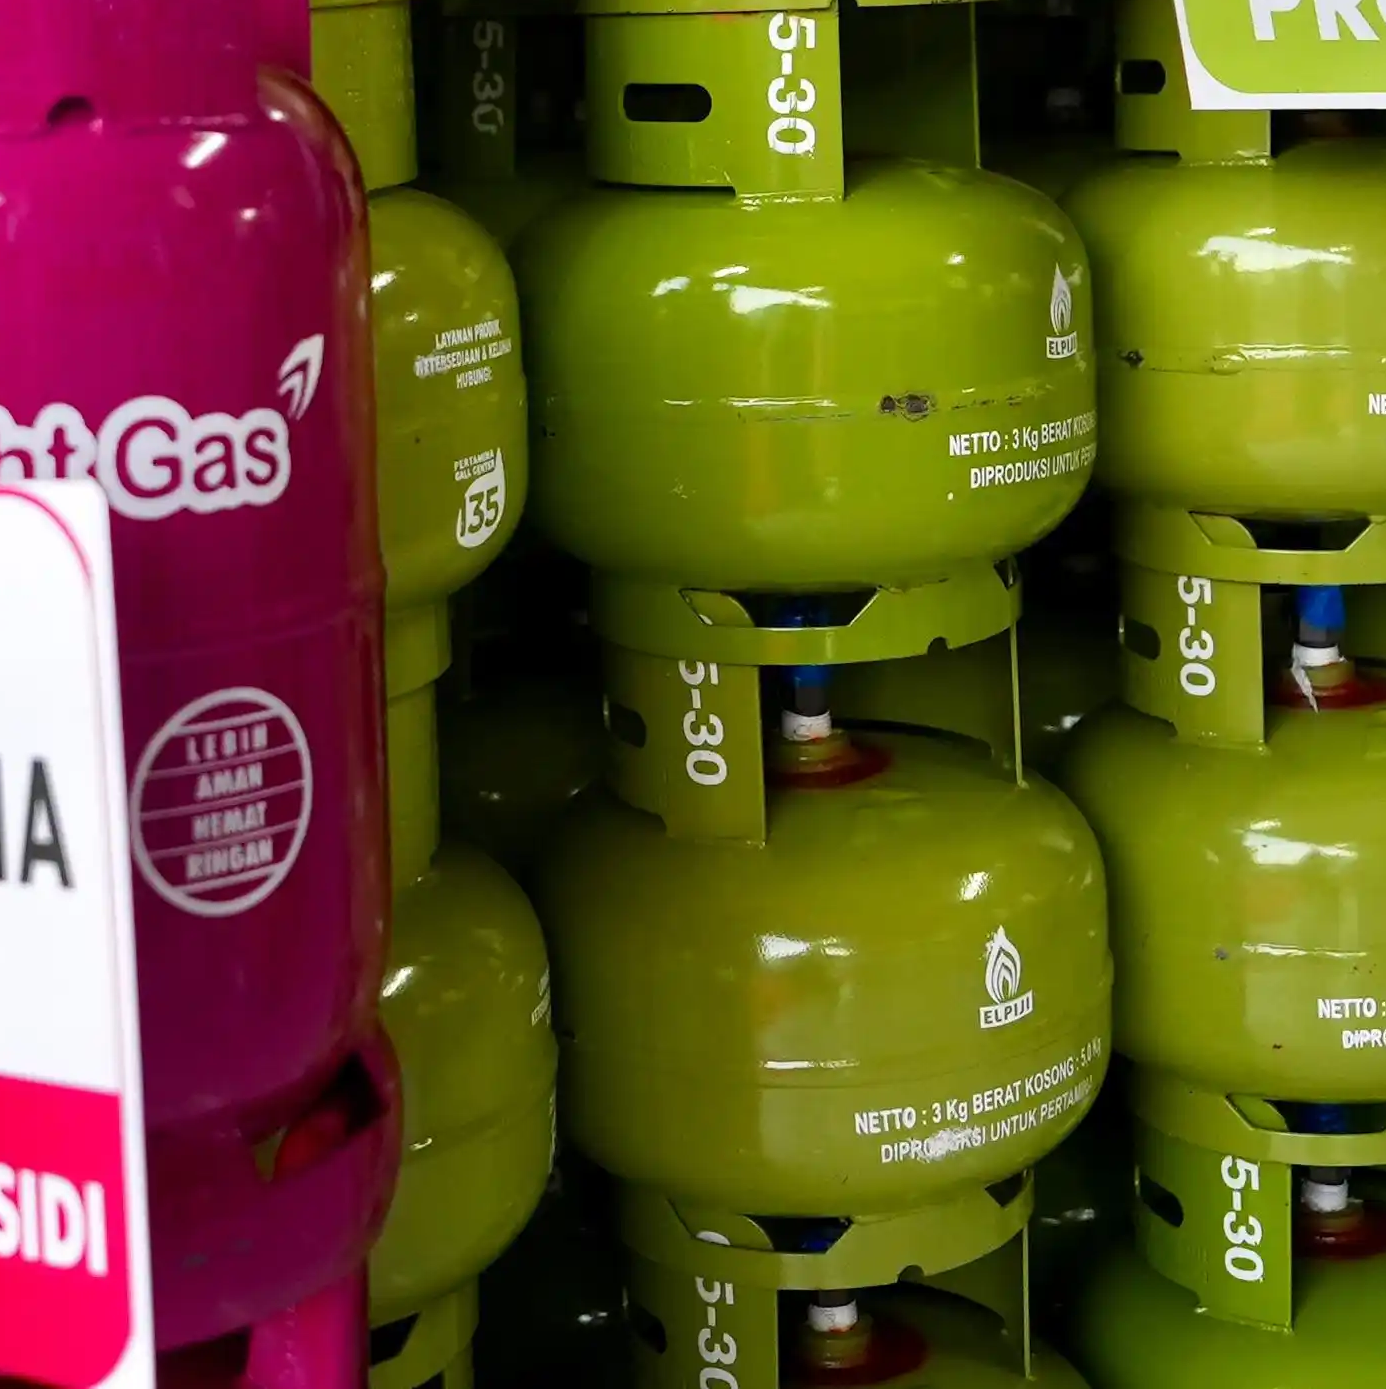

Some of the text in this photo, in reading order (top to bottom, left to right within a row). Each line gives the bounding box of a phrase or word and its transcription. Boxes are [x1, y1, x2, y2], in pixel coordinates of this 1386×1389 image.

[767, 12, 817, 156] 5-30
[99, 396, 291, 520] Gas
[459, 486, 499, 538] 135
[1177, 576, 1218, 696] 5-30
[186, 723, 267, 764] LEBIH
[195, 762, 263, 801] AMAN
[192, 801, 267, 841] HEMAT
[186, 836, 273, 880] RINGAN
[1317, 998, 1377, 1019] NETTO
